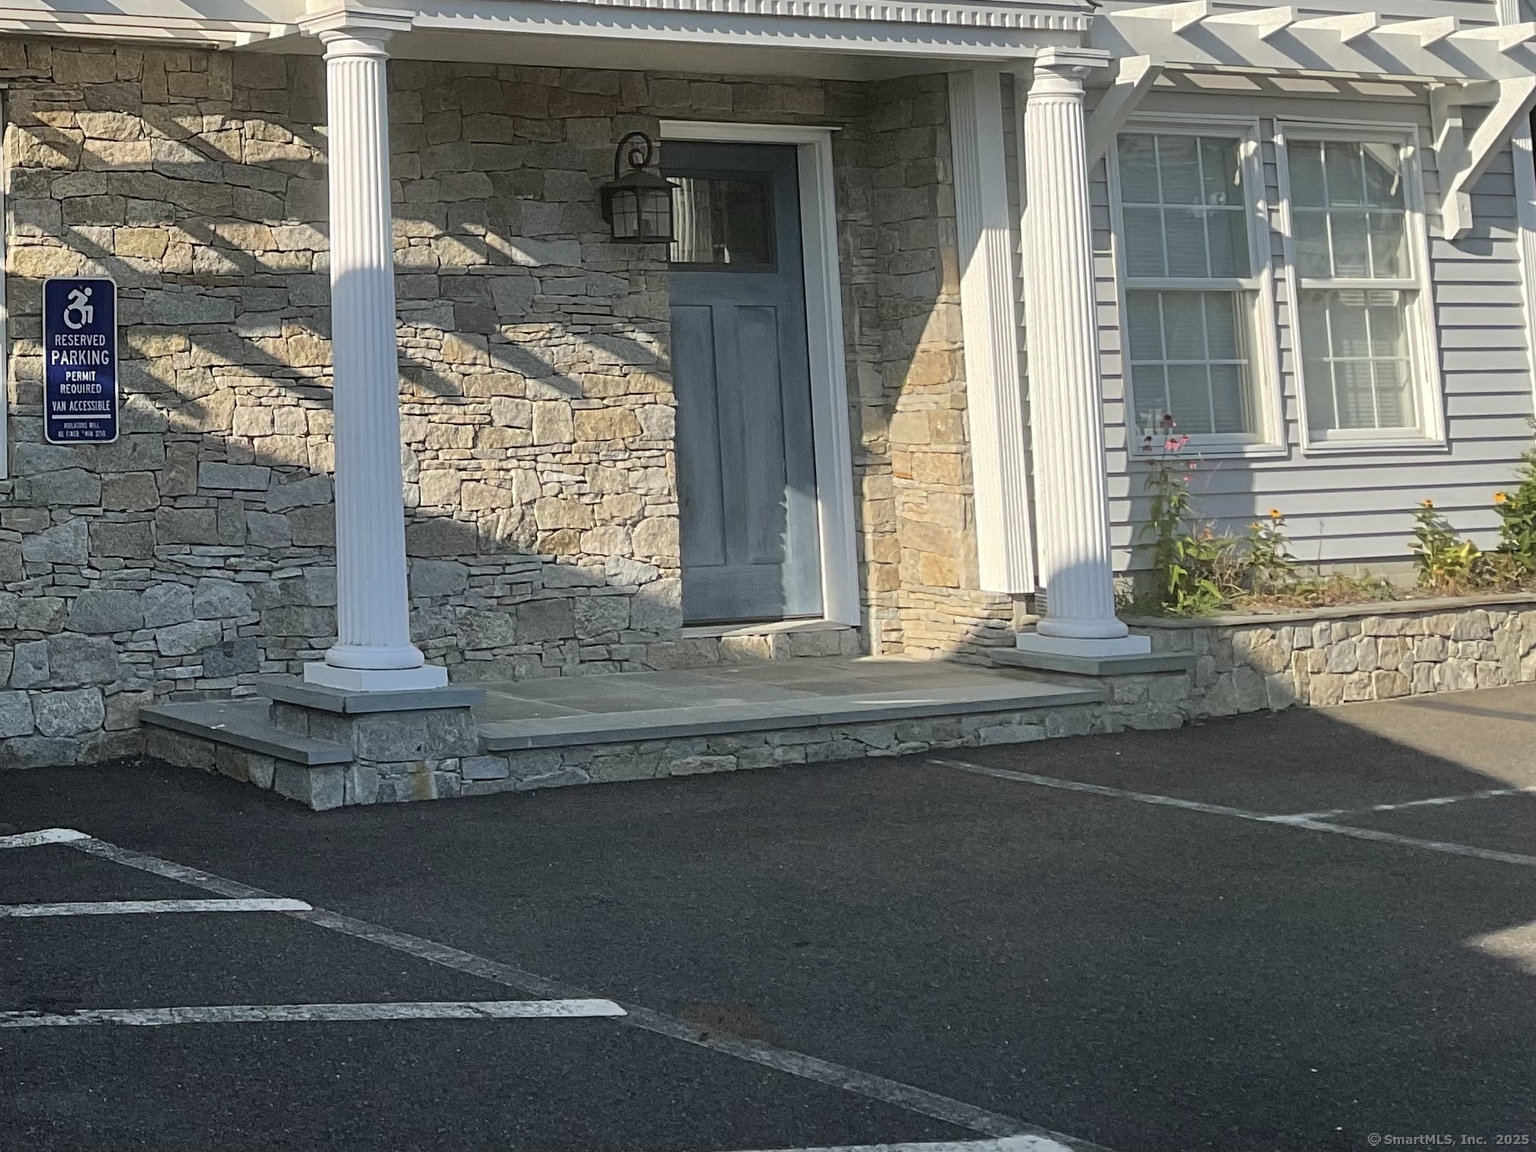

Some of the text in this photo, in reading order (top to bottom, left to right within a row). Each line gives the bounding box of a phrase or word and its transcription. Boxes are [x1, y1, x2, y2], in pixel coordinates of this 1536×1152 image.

[55, 334, 106, 346] RESERVED
[51, 350, 109, 365] PARKING
[65, 371, 96, 382] PERMIT
[60, 383, 102, 394] REQUIRED
[52, 400, 111, 412] VAN ACCESSIBLE
